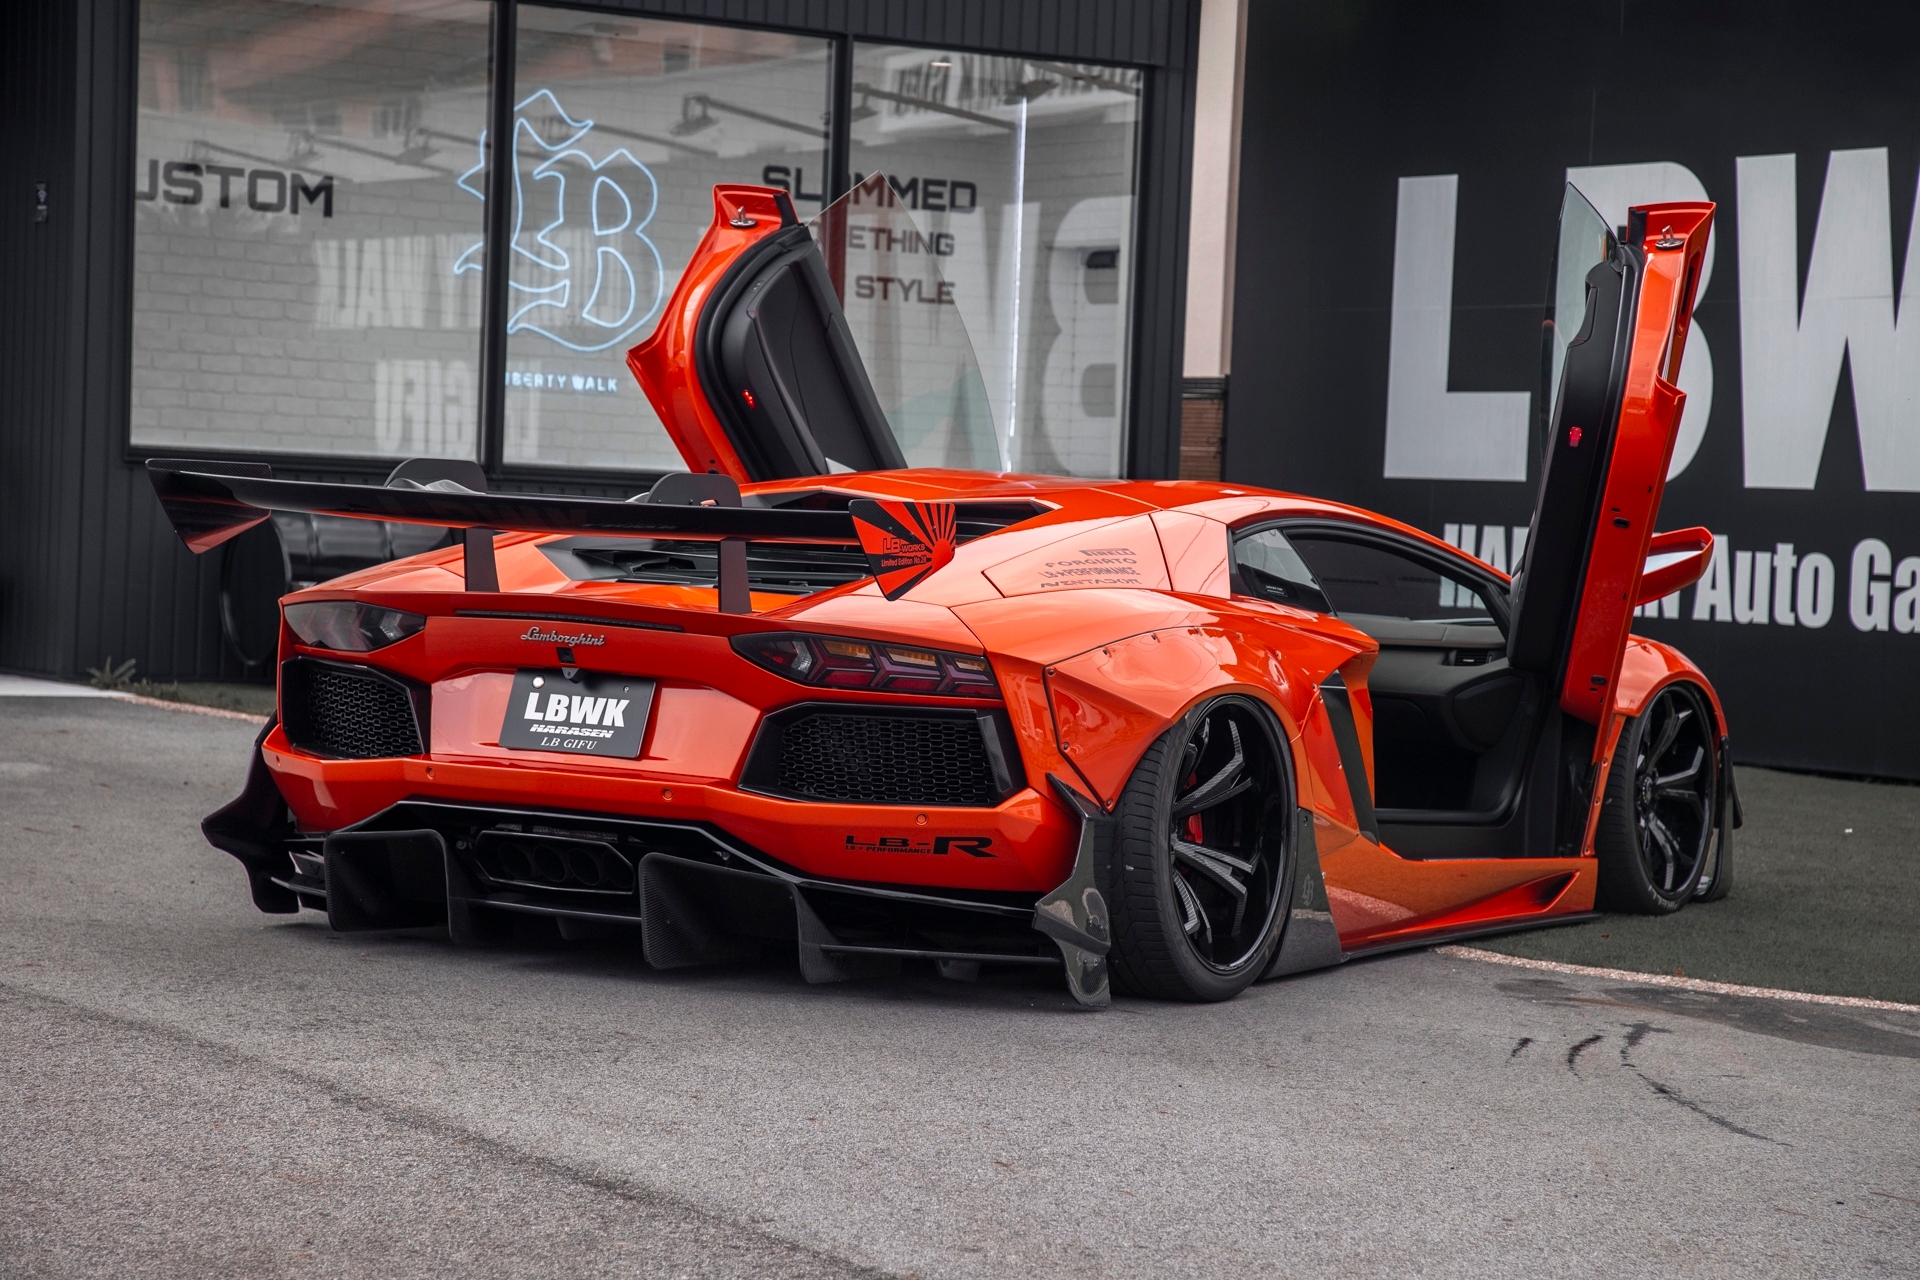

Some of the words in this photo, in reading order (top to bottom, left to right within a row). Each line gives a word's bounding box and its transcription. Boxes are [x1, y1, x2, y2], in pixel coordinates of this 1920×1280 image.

[135, 159, 334, 218] USTOM
[762, 164, 978, 214] SLMMED
[848, 225, 955, 257] ETHING
[855, 275, 956, 305] STYLE
[505, 371, 566, 390] IBERTY
[571, 374, 618, 393] WALK
[881, 559, 898, 567] Limited
[1692, 534, 1835, 629] Auto
[1849, 537, 1920, 634] Ga
[520, 626, 605, 647] Lamborghini
[523, 691, 630, 728] LBWK
[529, 723, 614, 739] HARASEN
[540, 736, 560, 747] LB
[563, 738, 598, 750] GIFU
[866, 846, 932, 855] PERFORMANCE
